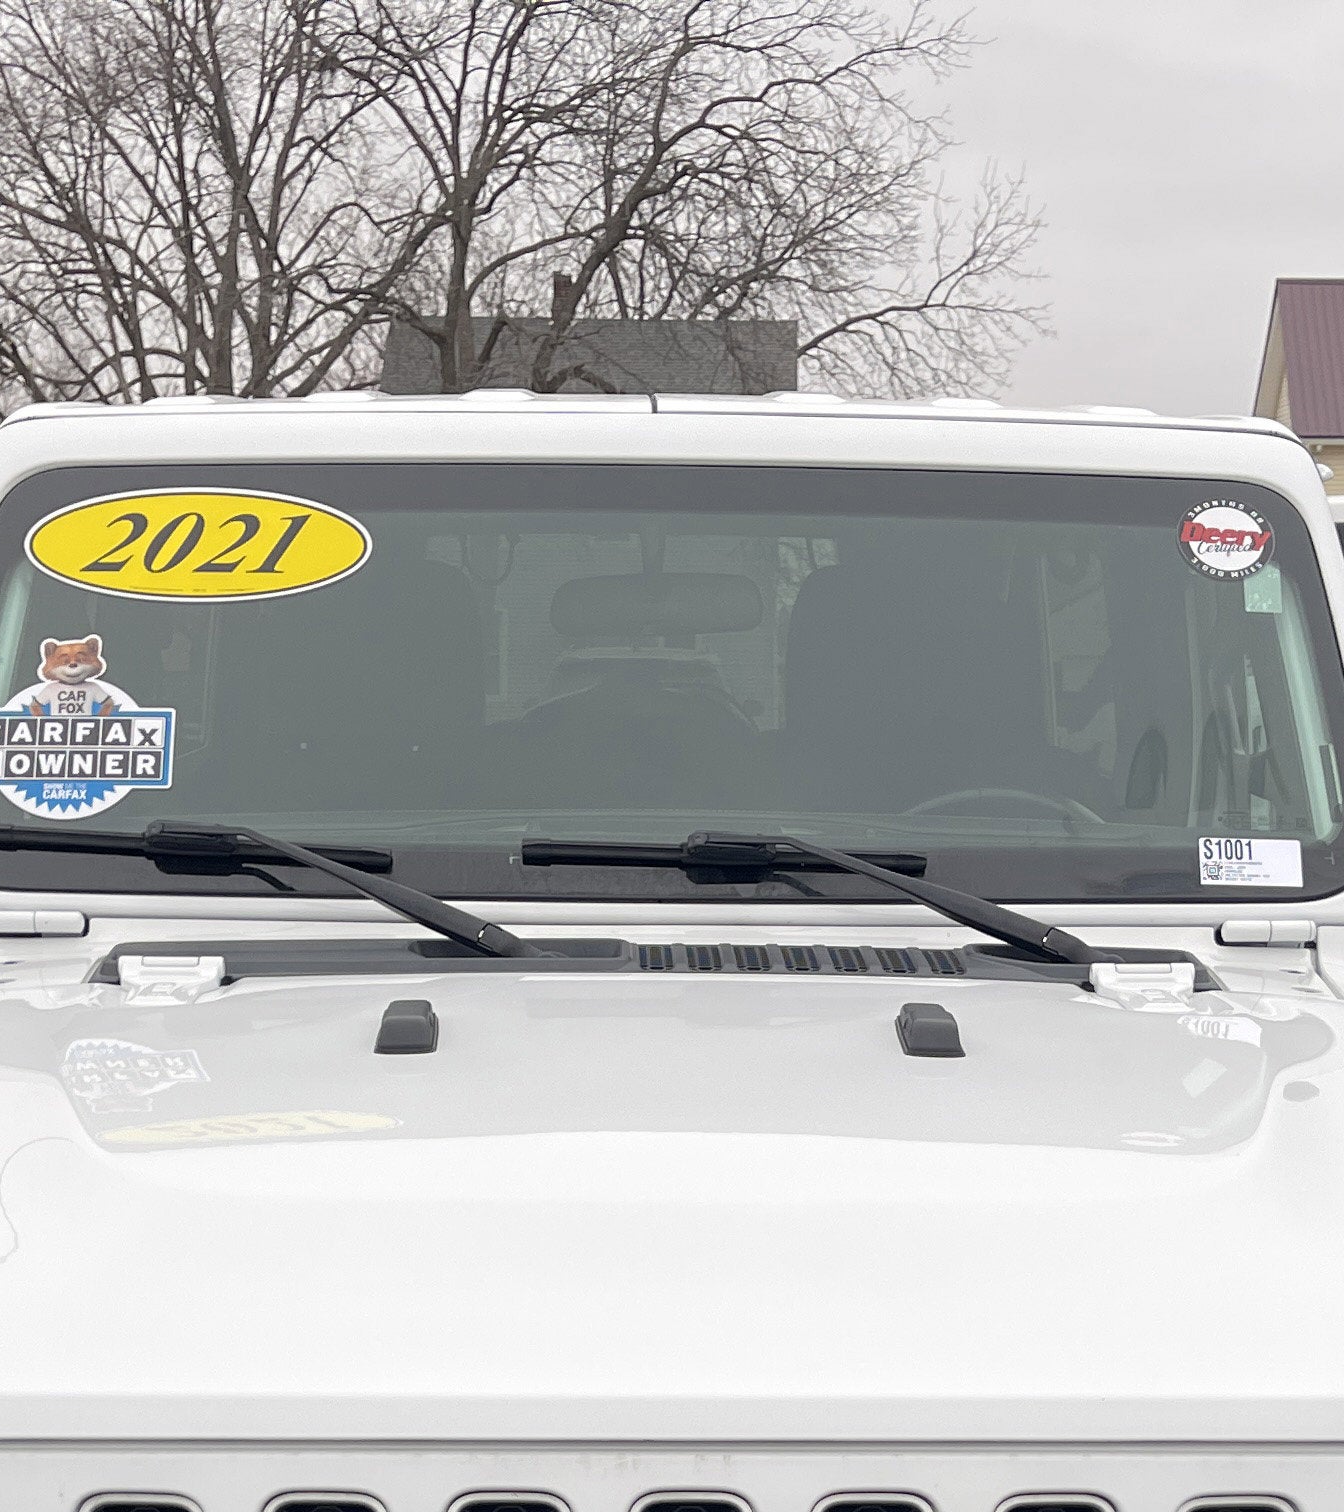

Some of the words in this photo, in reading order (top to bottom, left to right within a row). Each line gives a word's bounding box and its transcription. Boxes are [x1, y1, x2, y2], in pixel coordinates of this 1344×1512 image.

[79, 512, 312, 574] 2021
[1181, 521, 1272, 551] Deery
[58, 690, 86, 701] CAR
[58, 703, 85, 714] FOX
[42, 789, 87, 800] CARFAX
[1203, 838, 1253, 860] S1001
